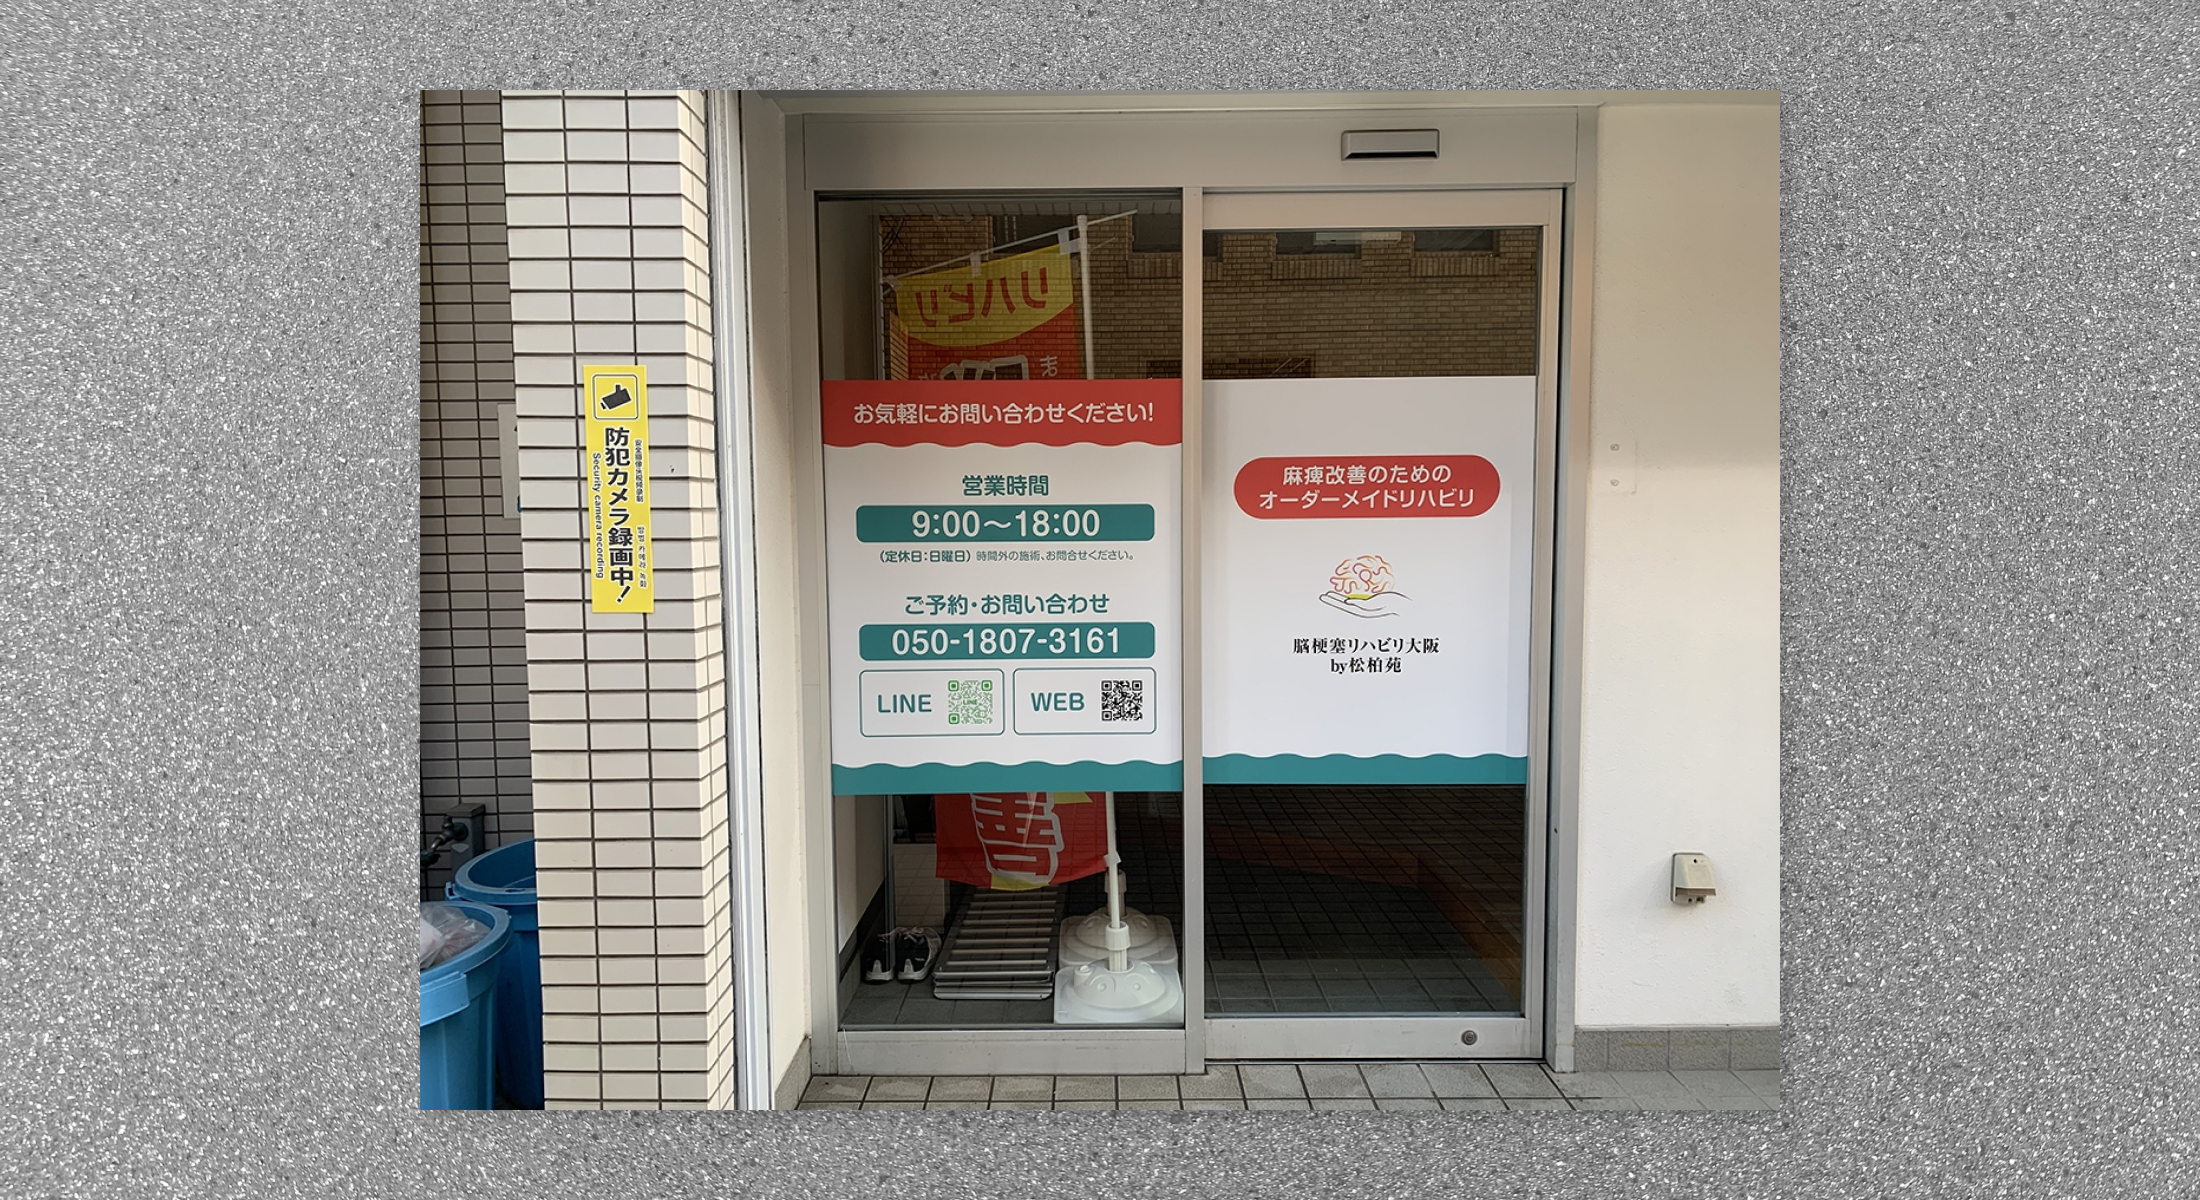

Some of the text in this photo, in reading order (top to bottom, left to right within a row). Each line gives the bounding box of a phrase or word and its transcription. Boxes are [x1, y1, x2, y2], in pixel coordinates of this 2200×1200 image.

[853, 402, 1154, 425] お気軽にお問い合わせください!
[962, 475, 1049, 497] 営業時間
[1282, 464, 1452, 486] 麻痺改善のための
[1259, 488, 1475, 510] オーダーメイドリハビリ
[592, 452, 605, 578] Security camera recording
[604, 426, 634, 603] 防犯カメラ録画中!
[904, 593, 1110, 616] ご予約・お問い合わせ
[891, 627, 1120, 655] 050-1807-3161
[1292, 637, 1440, 655] 脳梗塞リハビリ大阪
[1330, 657, 1403, 675] by松柏苑
[877, 693, 932, 714] LINE
[1030, 691, 1085, 712] WEB
